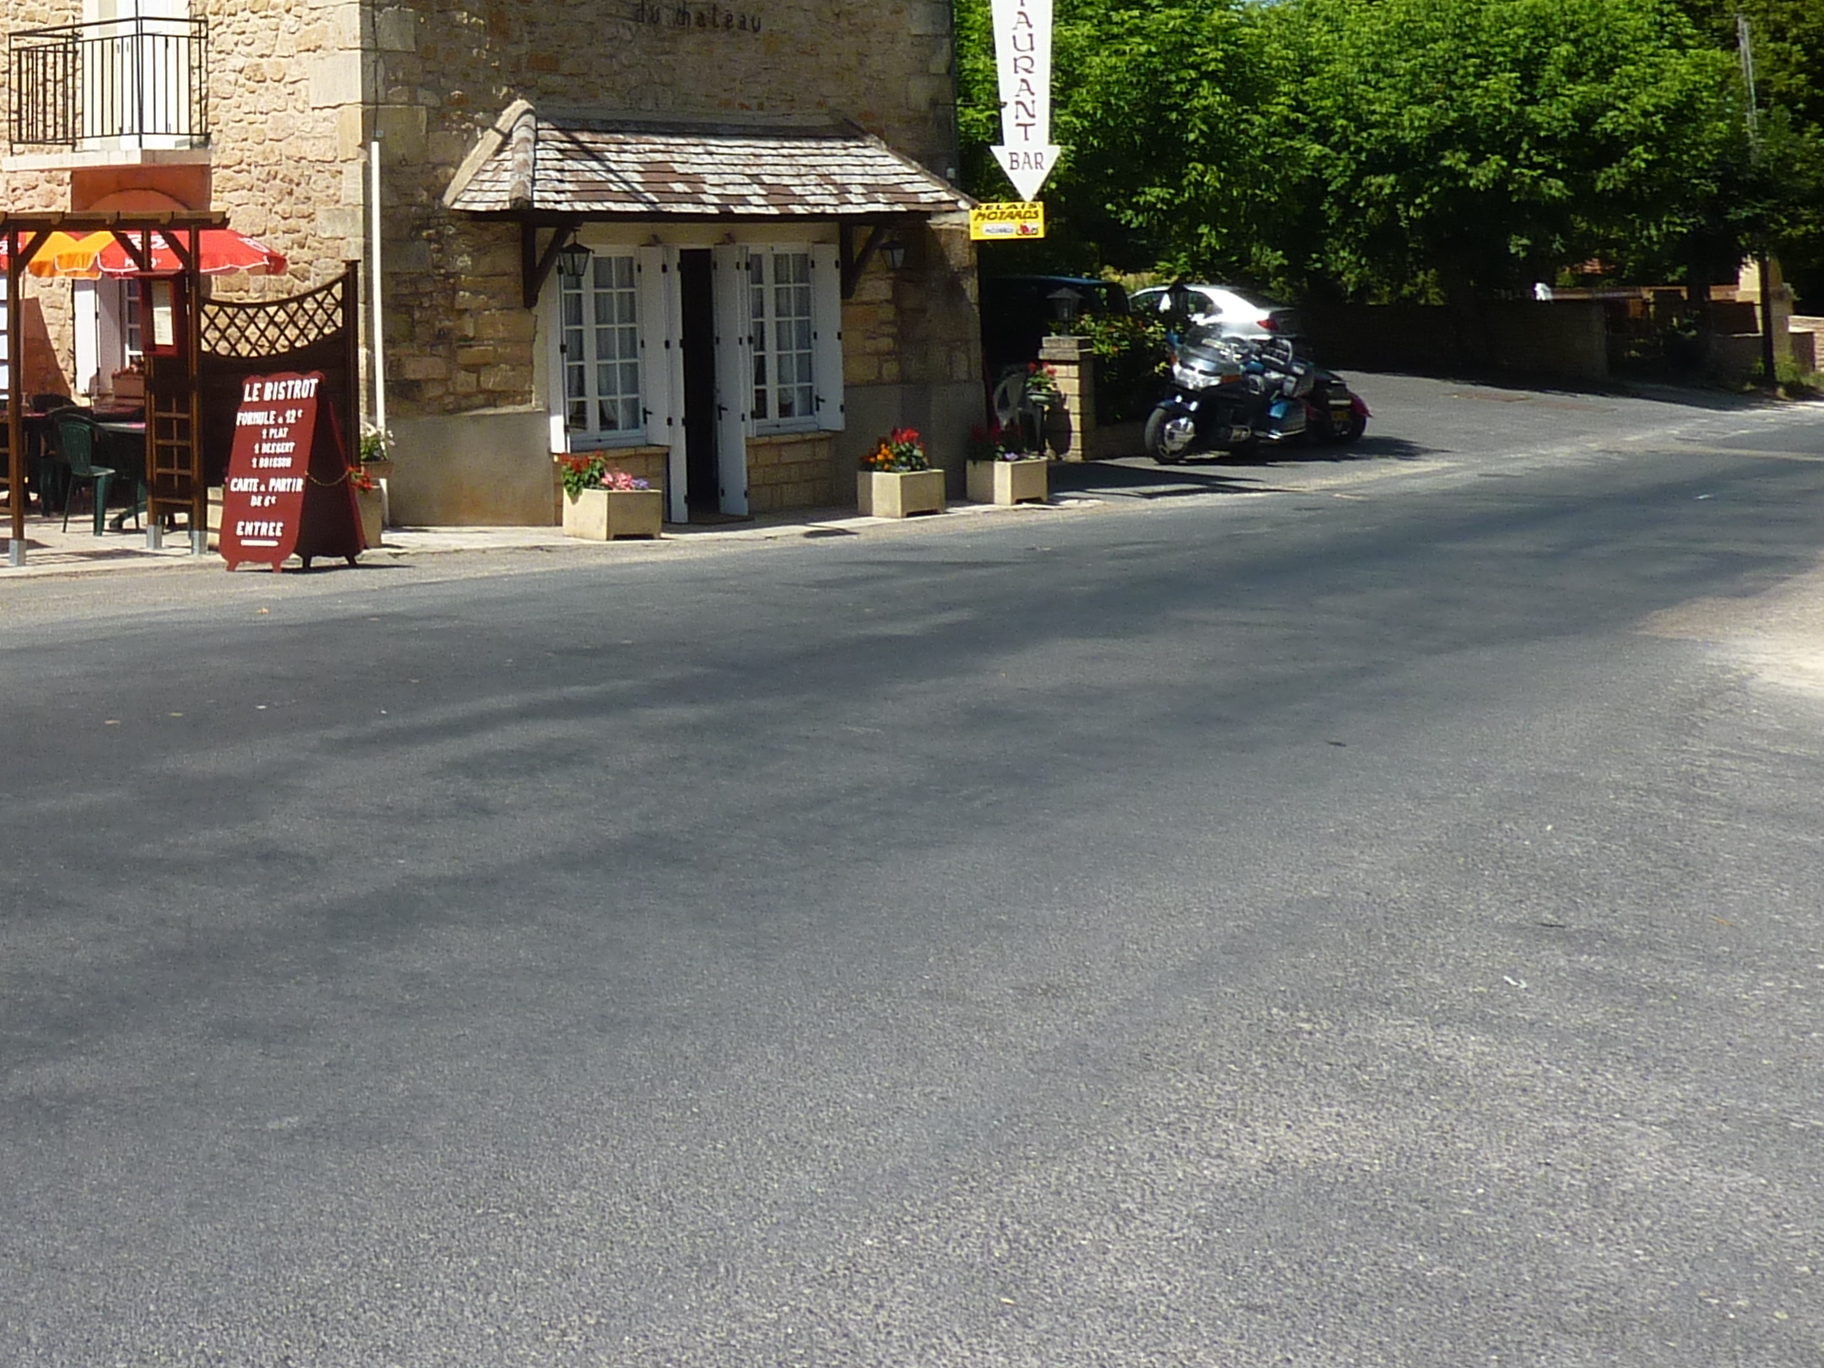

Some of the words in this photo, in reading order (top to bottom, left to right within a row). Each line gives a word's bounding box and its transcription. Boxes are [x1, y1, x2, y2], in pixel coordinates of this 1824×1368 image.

[1008, 151, 1045, 171] BAR
[973, 209, 1040, 222] MOTARDS
[243, 382, 263, 403] LE
[263, 378, 320, 402] BISTROT
[236, 410, 277, 427] FORMULE
[268, 427, 289, 439] PLAT
[261, 441, 296, 454] DESSERT
[258, 457, 293, 469] BOISSON
[229, 477, 260, 493] CARTE
[268, 477, 304, 493] PARTIR
[250, 494, 263, 507] DE
[236, 520, 284, 537] ENTREE
